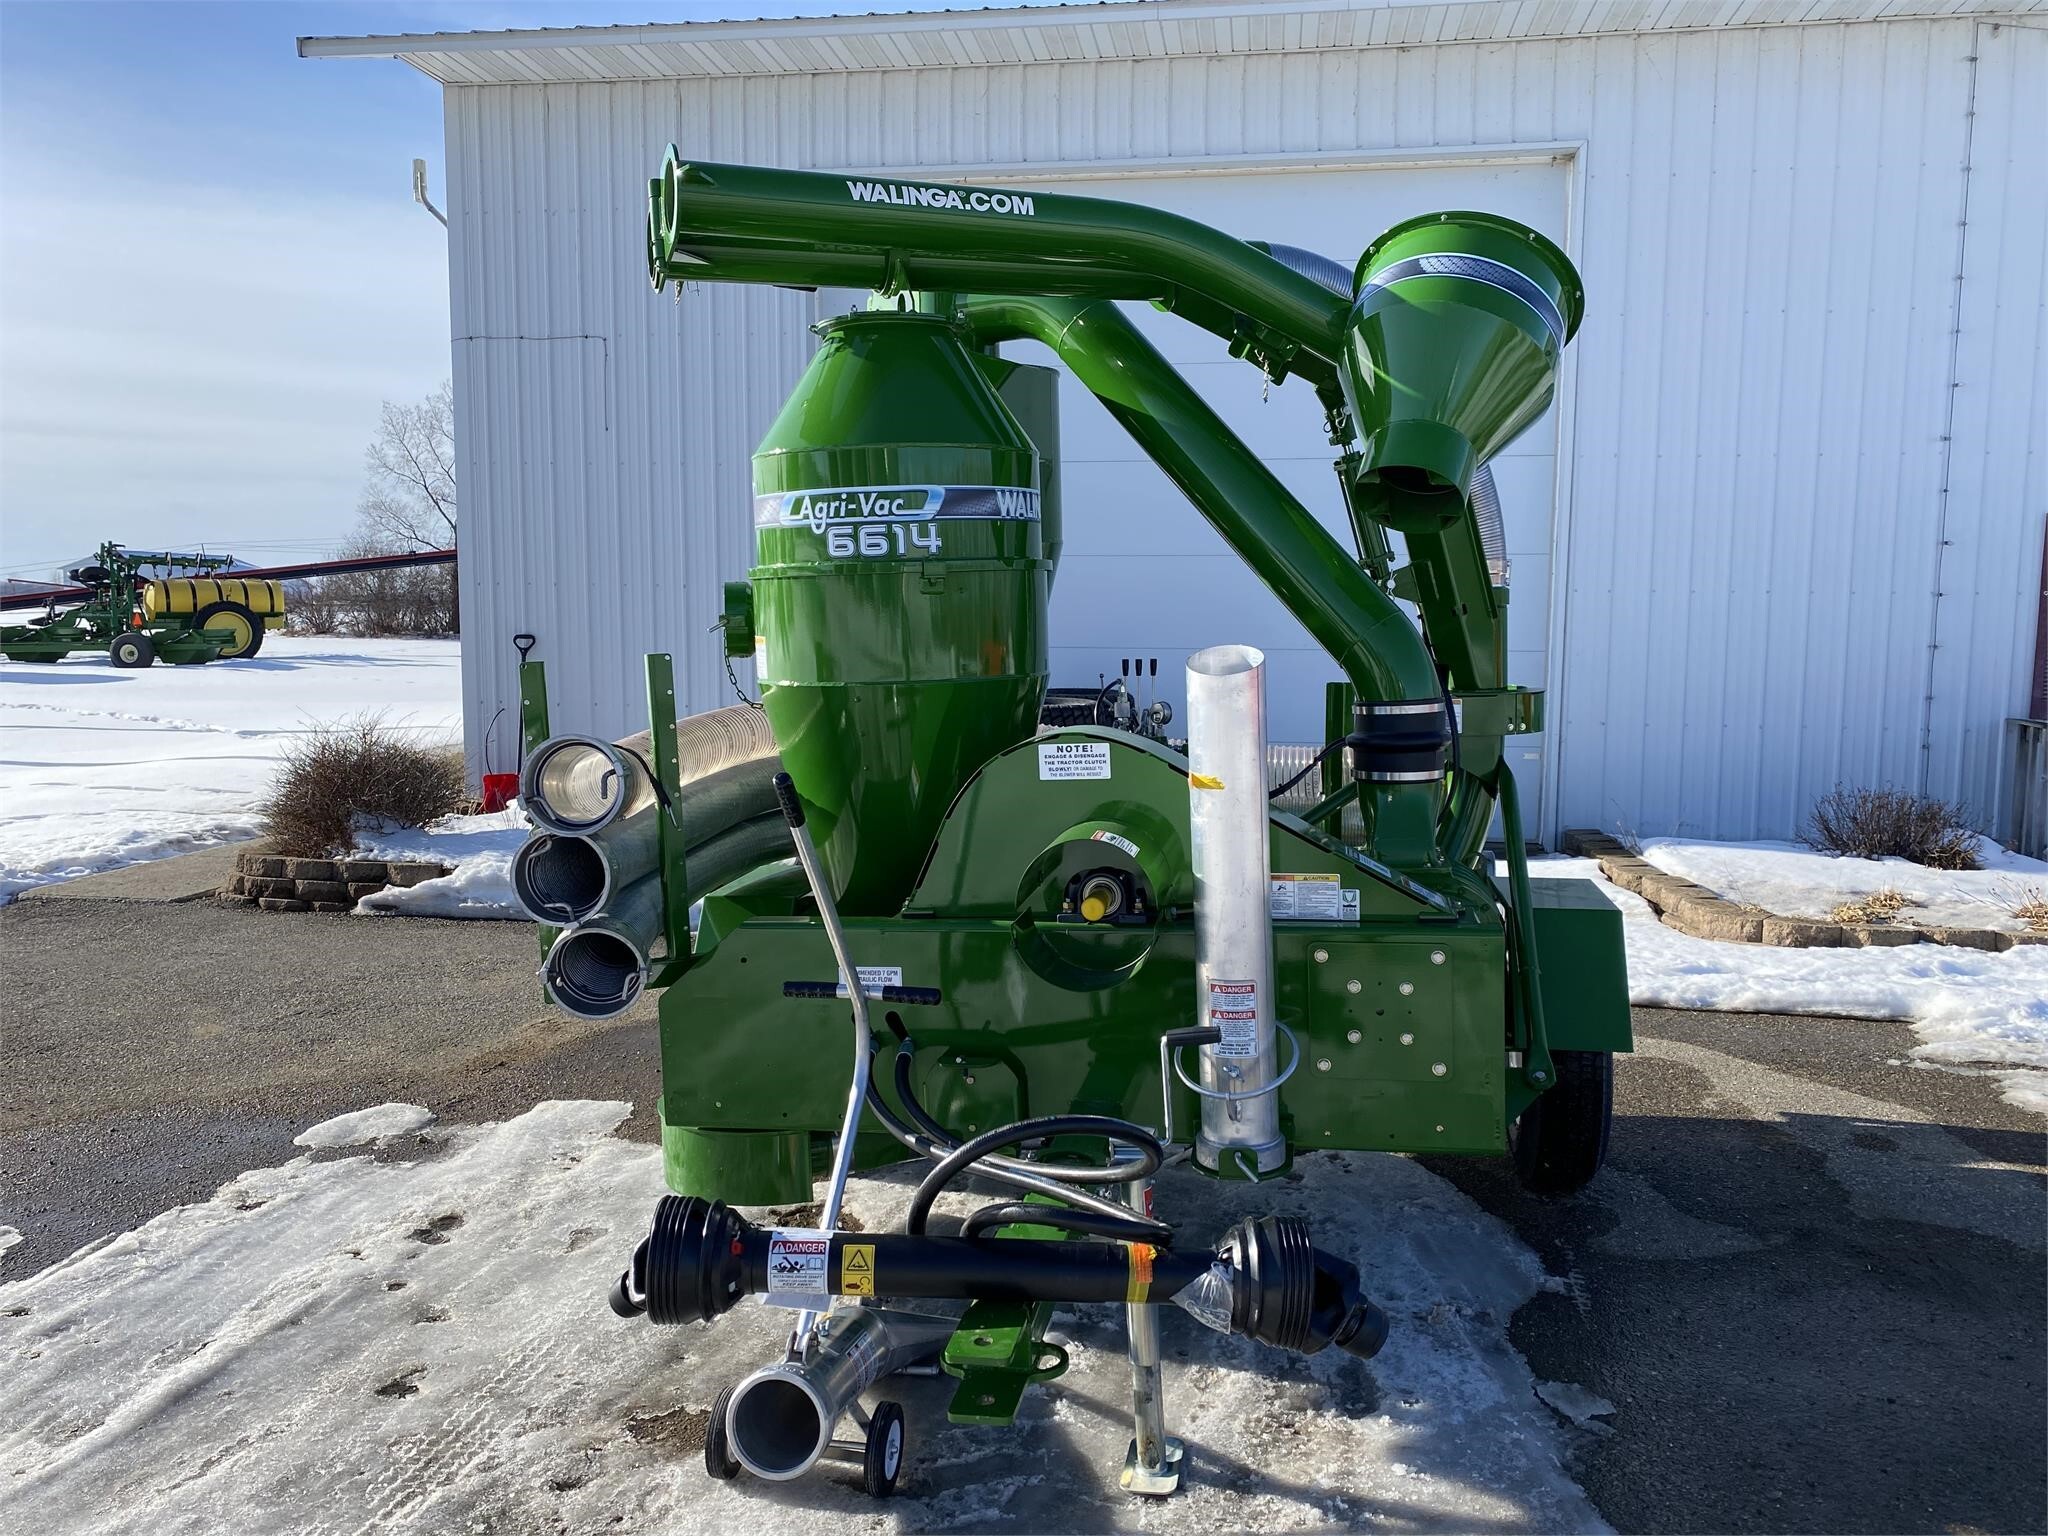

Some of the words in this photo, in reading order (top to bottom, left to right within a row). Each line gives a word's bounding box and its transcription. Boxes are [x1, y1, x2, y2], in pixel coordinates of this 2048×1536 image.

[799, 491, 906, 535] Agri-Vac
[826, 522, 943, 558] 6614
[1056, 745, 1094, 753] NOTE!
[786, 1243, 826, 1253] DANGER
